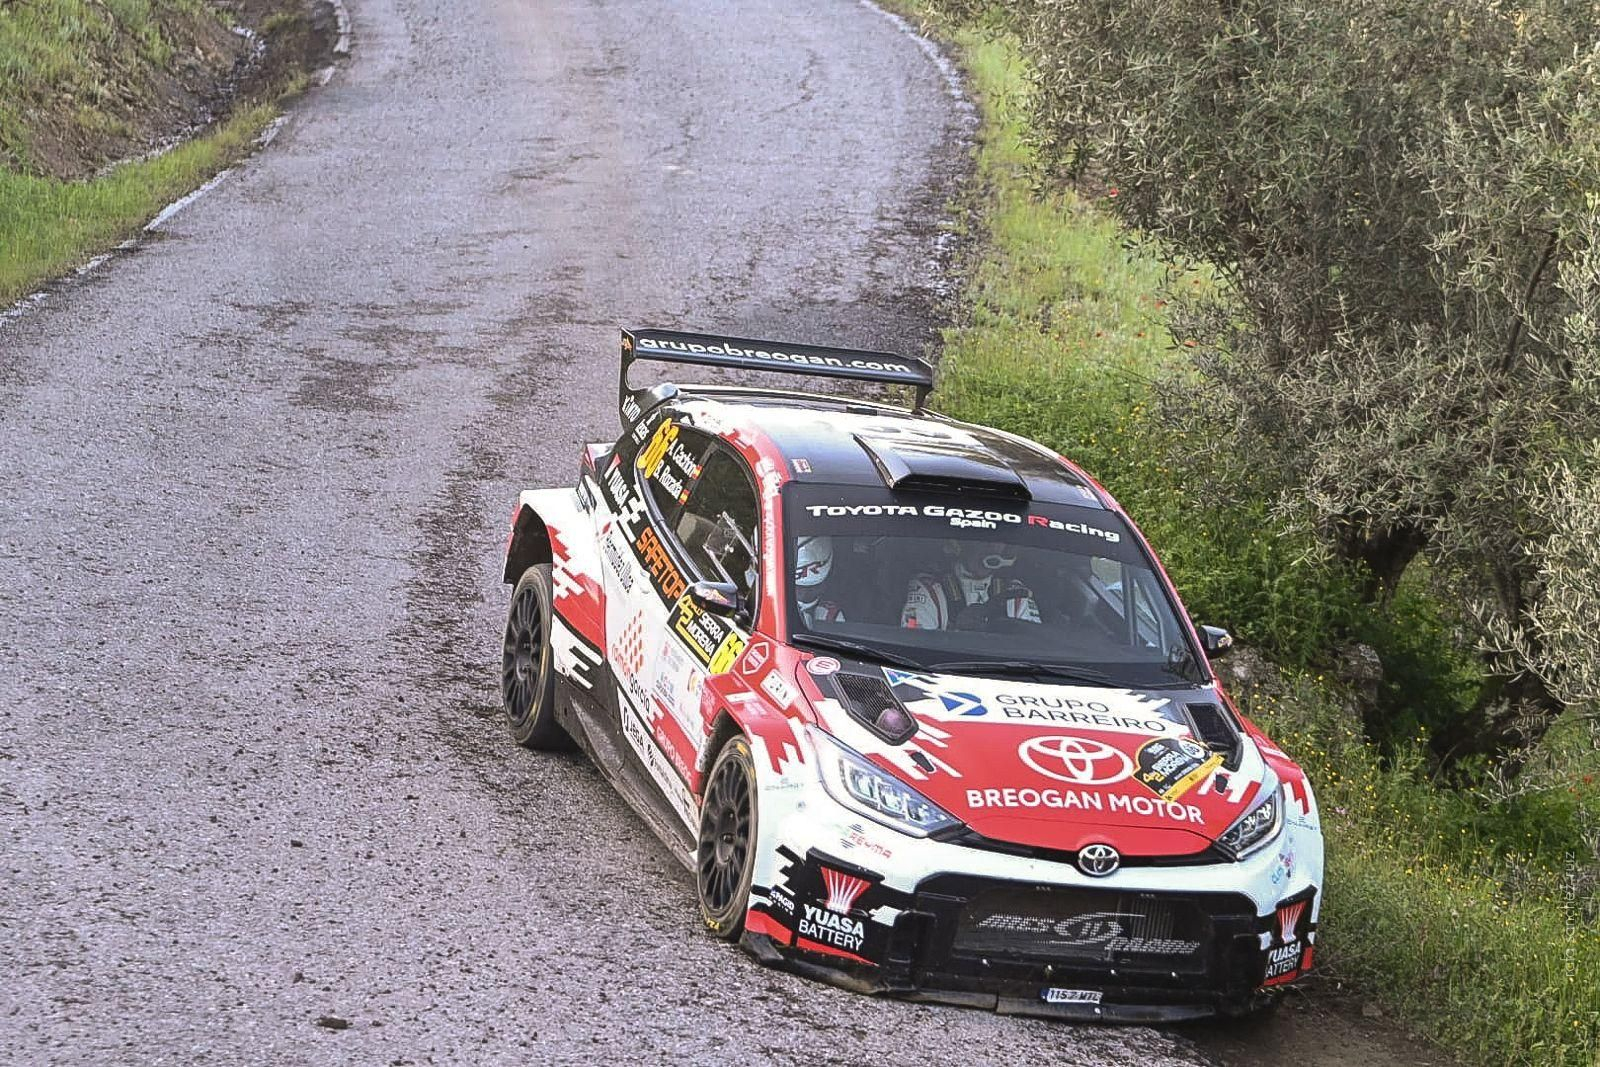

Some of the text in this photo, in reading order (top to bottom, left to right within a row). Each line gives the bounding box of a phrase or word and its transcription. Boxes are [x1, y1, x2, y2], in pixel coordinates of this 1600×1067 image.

[639, 337, 911, 373] grupobreogan.com
[806, 504, 1121, 543] TOYOTA GAZOO Racing
[949, 517, 997, 530] Spain
[995, 693, 1110, 713] GRUPO
[1003, 707, 1165, 733] BARREIRO
[966, 788, 1206, 825] BREOGAN MOTOR
[798, 918, 863, 952] BATTERY
[803, 904, 865, 939] YUASA
